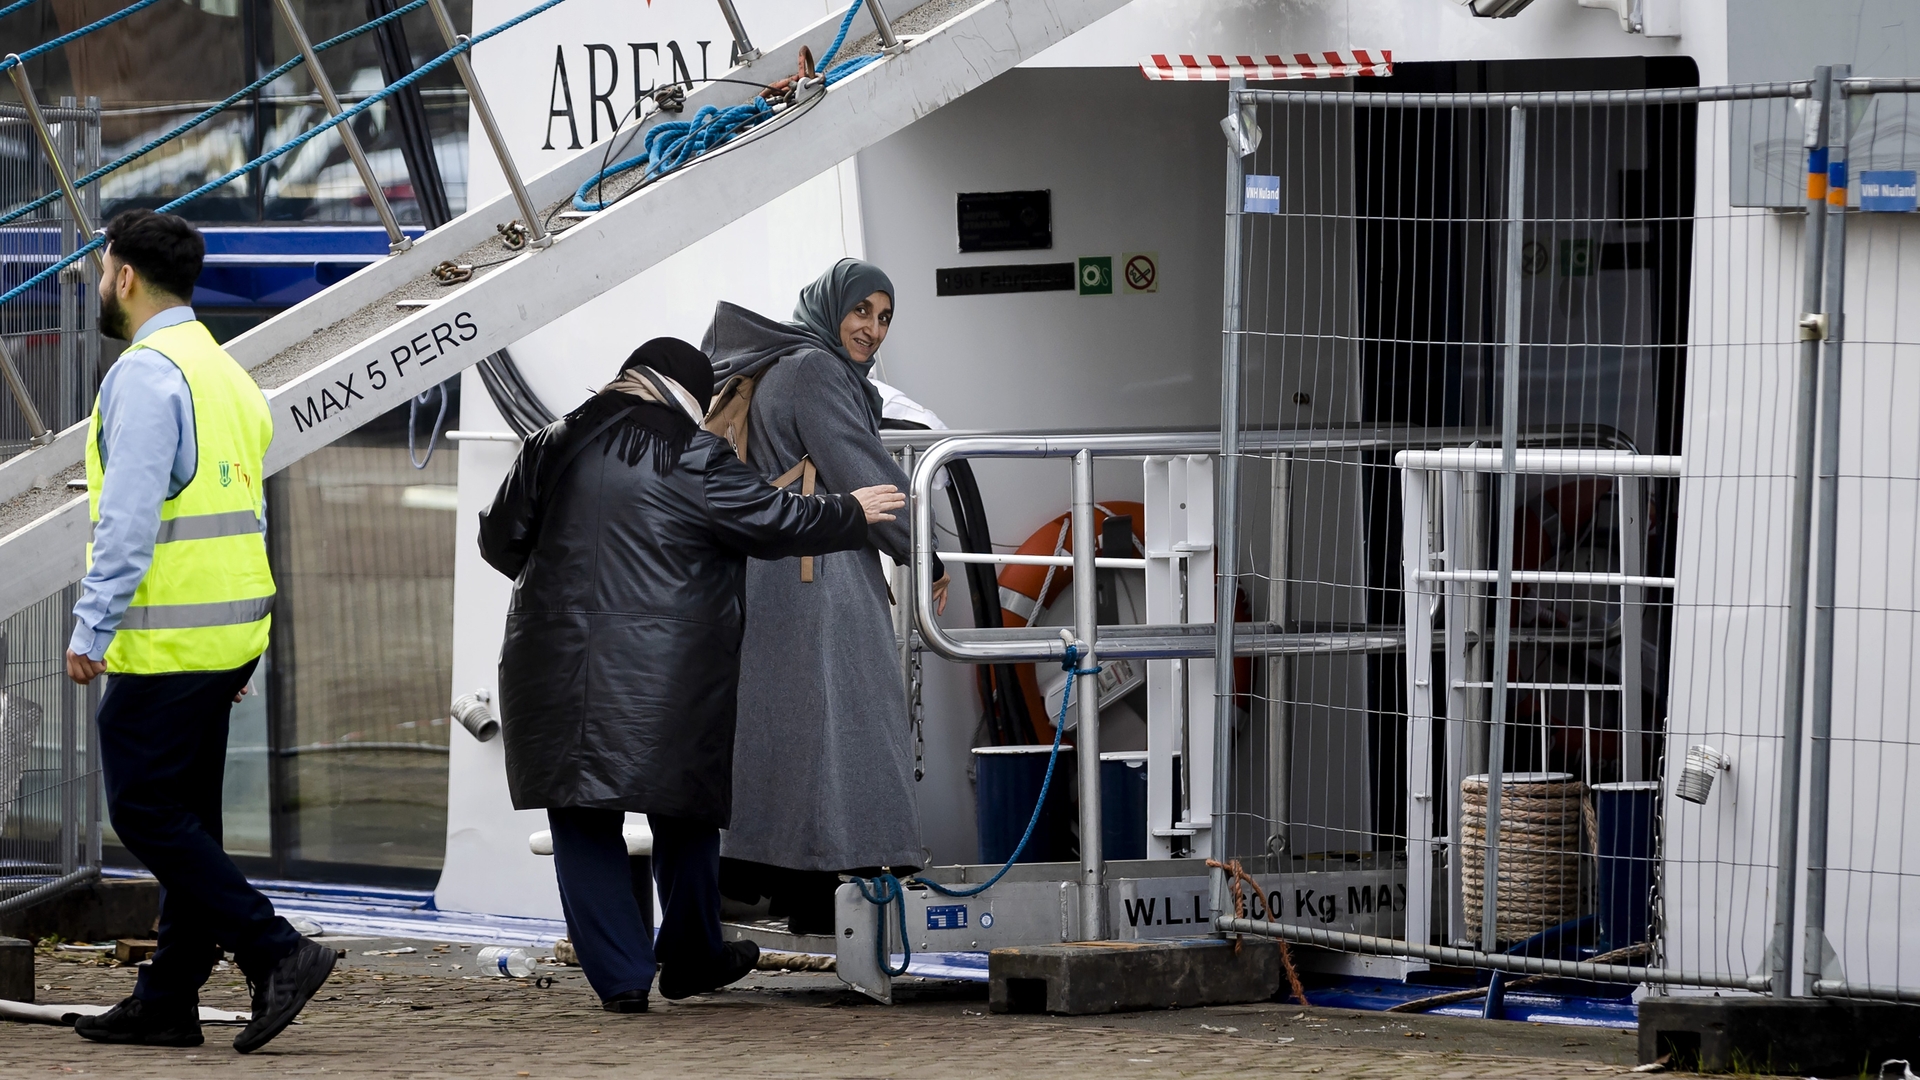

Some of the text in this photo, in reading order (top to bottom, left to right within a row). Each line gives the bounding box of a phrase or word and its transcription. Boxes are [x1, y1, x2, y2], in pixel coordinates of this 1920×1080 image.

[541, 40, 740, 150] AREN
[1862, 184, 1916, 197] VNH Nuland
[290, 311, 478, 433] MAX 5 PERS
[1296, 889, 1336, 923] Kg
